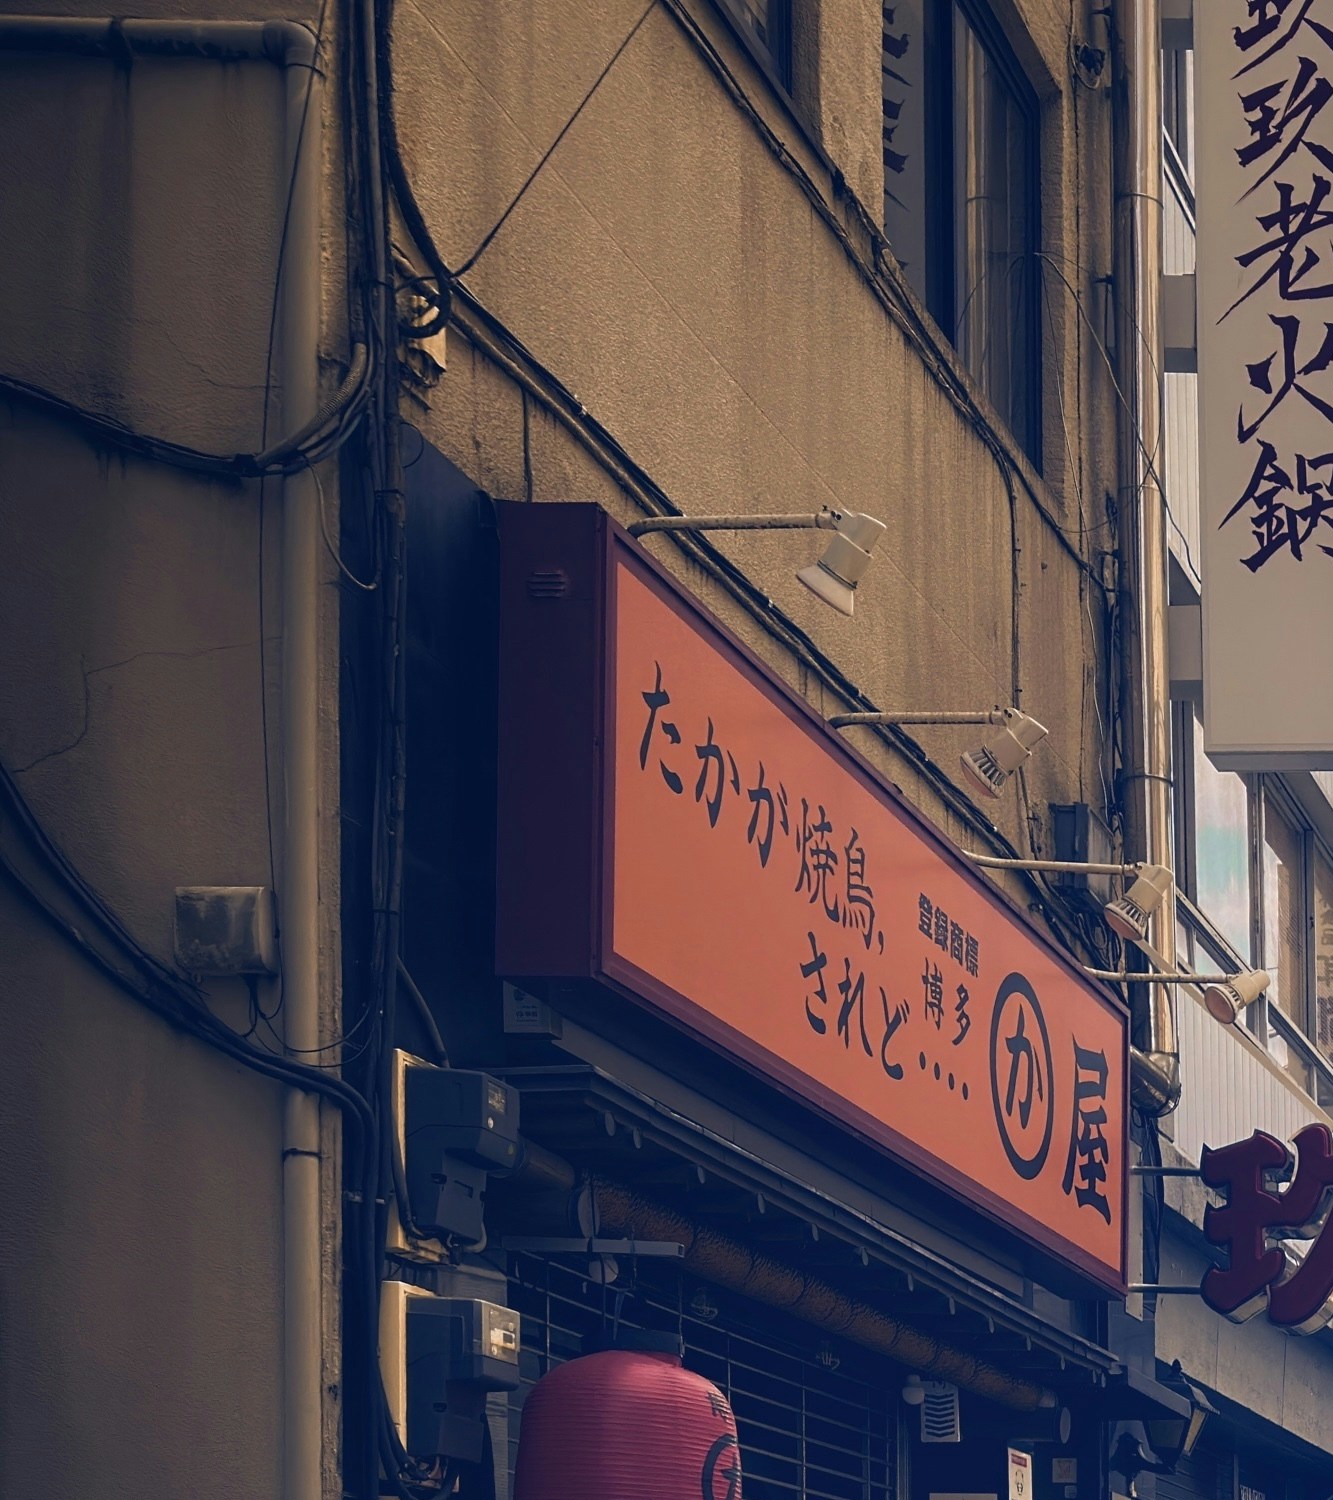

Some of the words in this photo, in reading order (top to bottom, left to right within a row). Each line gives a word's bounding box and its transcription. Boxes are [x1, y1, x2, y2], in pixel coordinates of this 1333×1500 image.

[918, 892, 979, 978] 登録商標
[922, 957, 971, 1046] 博多
